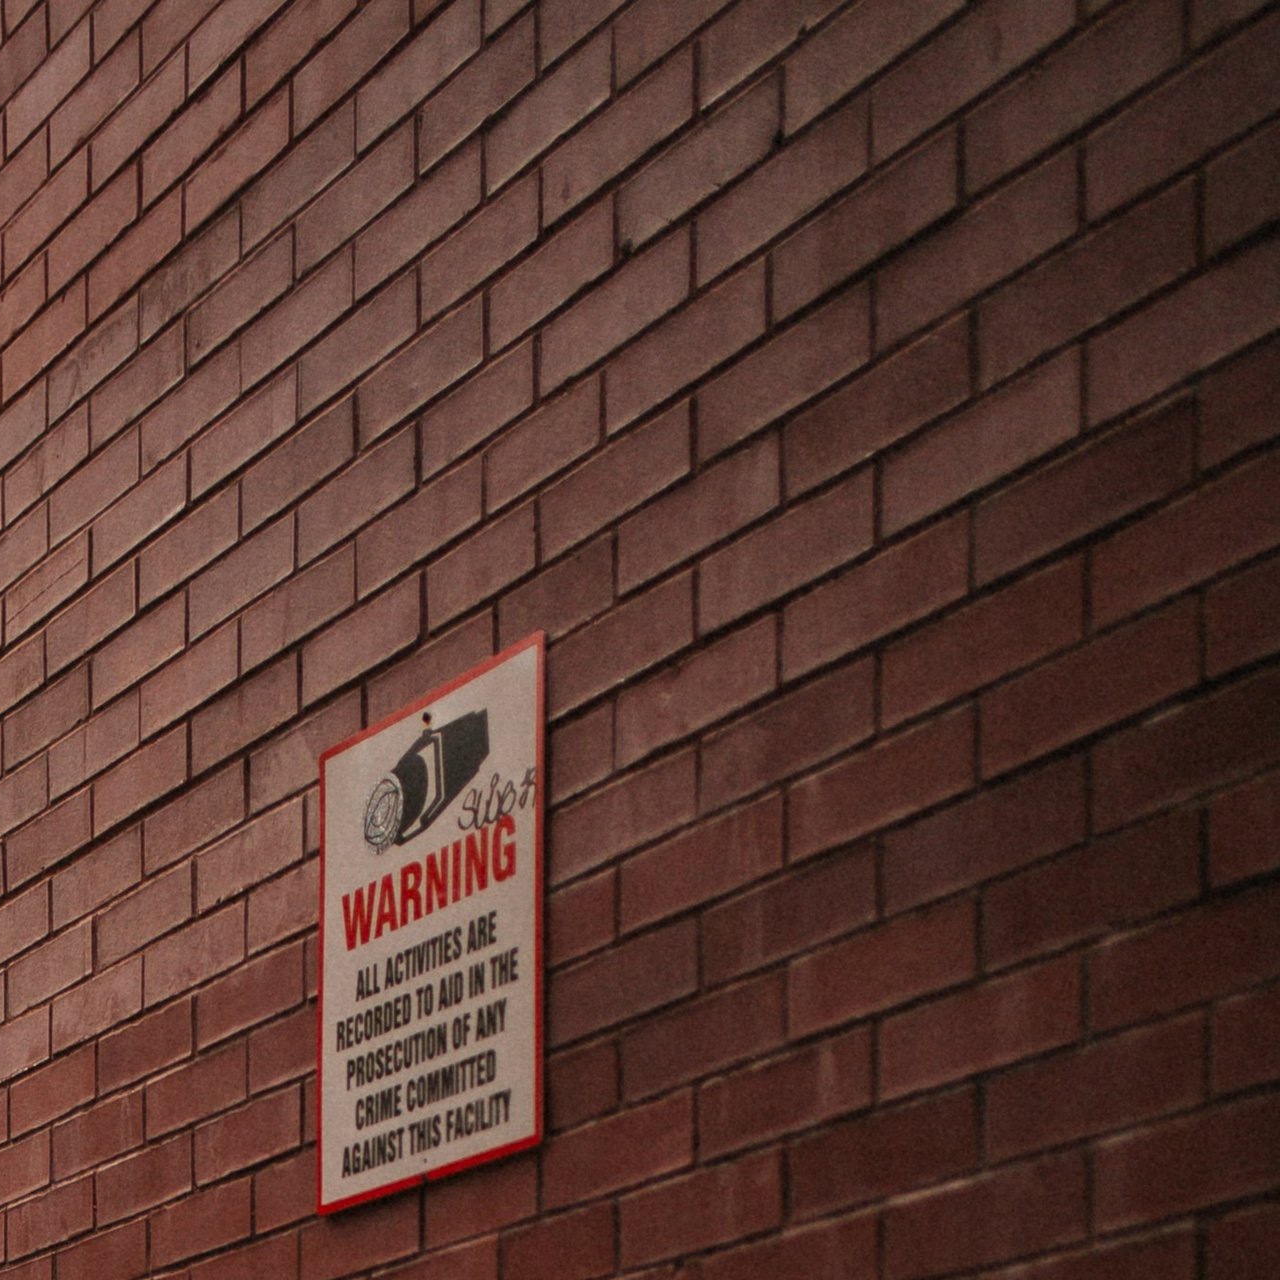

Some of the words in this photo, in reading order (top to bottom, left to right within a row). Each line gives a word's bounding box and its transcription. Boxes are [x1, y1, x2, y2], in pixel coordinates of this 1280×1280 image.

[341, 814, 517, 952] WARNING
[336, 993, 411, 1052] RECORDED
[416, 983, 433, 1019] TO
[438, 971, 464, 1012] AID
[469, 962, 485, 999] IN
[490, 947, 519, 989] THE
[355, 963, 380, 1002] ALL
[384, 926, 462, 991] ACTIVITIES
[466, 910, 497, 954] ARE
[346, 1022, 447, 1091] PROSECUTION
[452, 1012, 471, 1050] OF
[475, 998, 507, 1042] ANY
[355, 1084, 402, 1130] CRIME
[407, 1049, 497, 1112] COMMITTED
[341, 1127, 404, 1178] AGAINST
[408, 1114, 441, 1155] THIS
[445, 1089, 512, 1143] FACILITY
